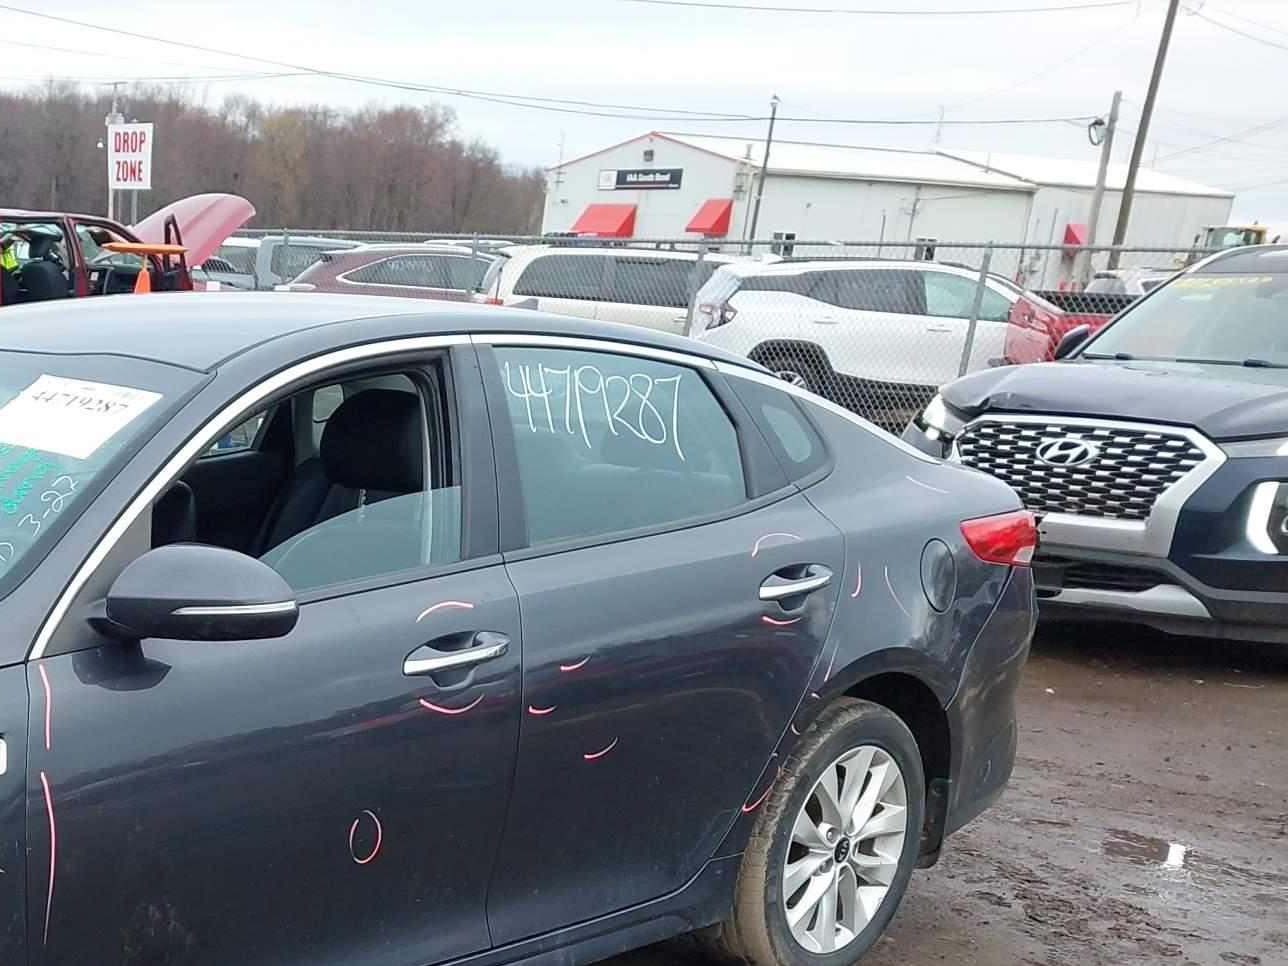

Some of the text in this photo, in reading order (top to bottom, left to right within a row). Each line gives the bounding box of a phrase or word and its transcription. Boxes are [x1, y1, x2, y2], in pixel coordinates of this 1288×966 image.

[115, 131, 146, 153] DROP
[116, 160, 143, 182] ZONE
[18, 475, 80, 536] 3-27
